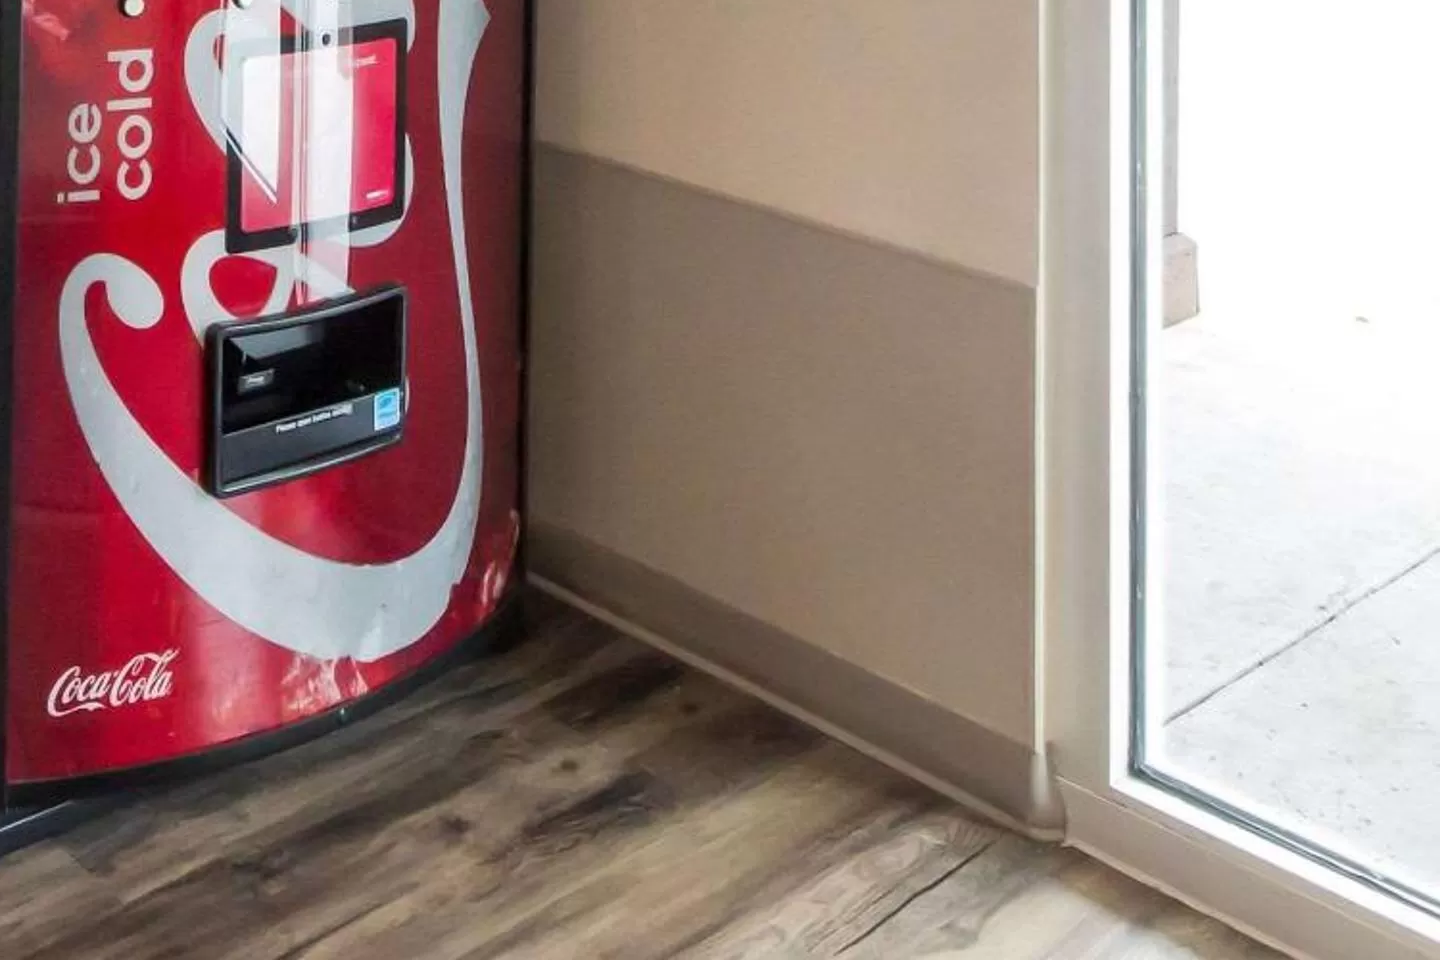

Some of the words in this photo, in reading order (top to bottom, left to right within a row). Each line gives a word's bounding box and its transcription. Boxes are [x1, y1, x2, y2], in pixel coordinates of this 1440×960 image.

[57, 103, 103, 205] ice
[106, 48, 154, 200] cold
[47, 647, 180, 717] Coca-Cola
